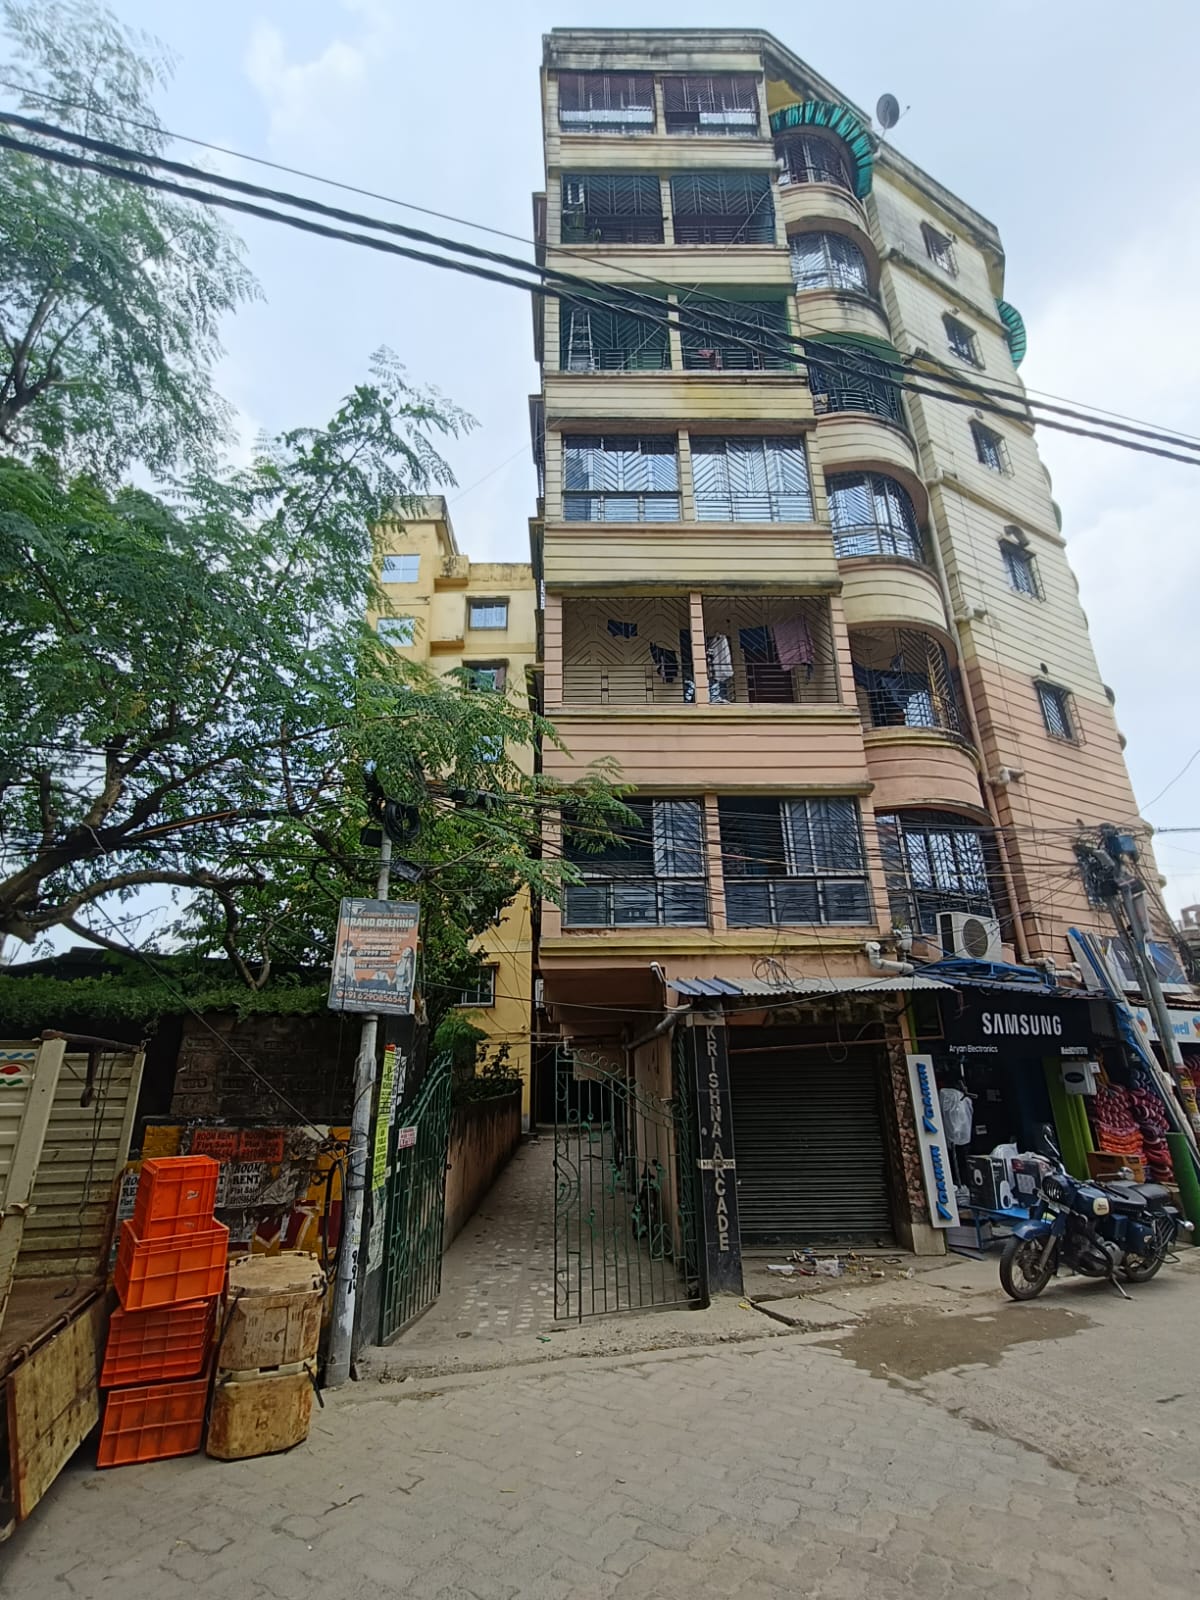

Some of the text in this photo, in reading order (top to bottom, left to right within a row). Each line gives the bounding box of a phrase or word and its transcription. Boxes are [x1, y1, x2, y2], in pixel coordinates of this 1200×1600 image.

[377, 919, 415, 928] OPENING
[981, 1012, 1062, 1036] SAMSUNG
[949, 1044, 999, 1055] Aryan Electronics
[706, 1025, 722, 1139] KRISHNA
[916, 1063, 935, 1119] DAIKIN
[233, 1163, 262, 1174] ROOM
[929, 1144, 948, 1204] DAIKIN
[123, 1176, 138, 1187] RO
[232, 1175, 260, 1185] RENT
[122, 1187, 137, 1197] RE
[231, 1186, 243, 1195] Flat
[713, 1143, 731, 1252] ARCADE
